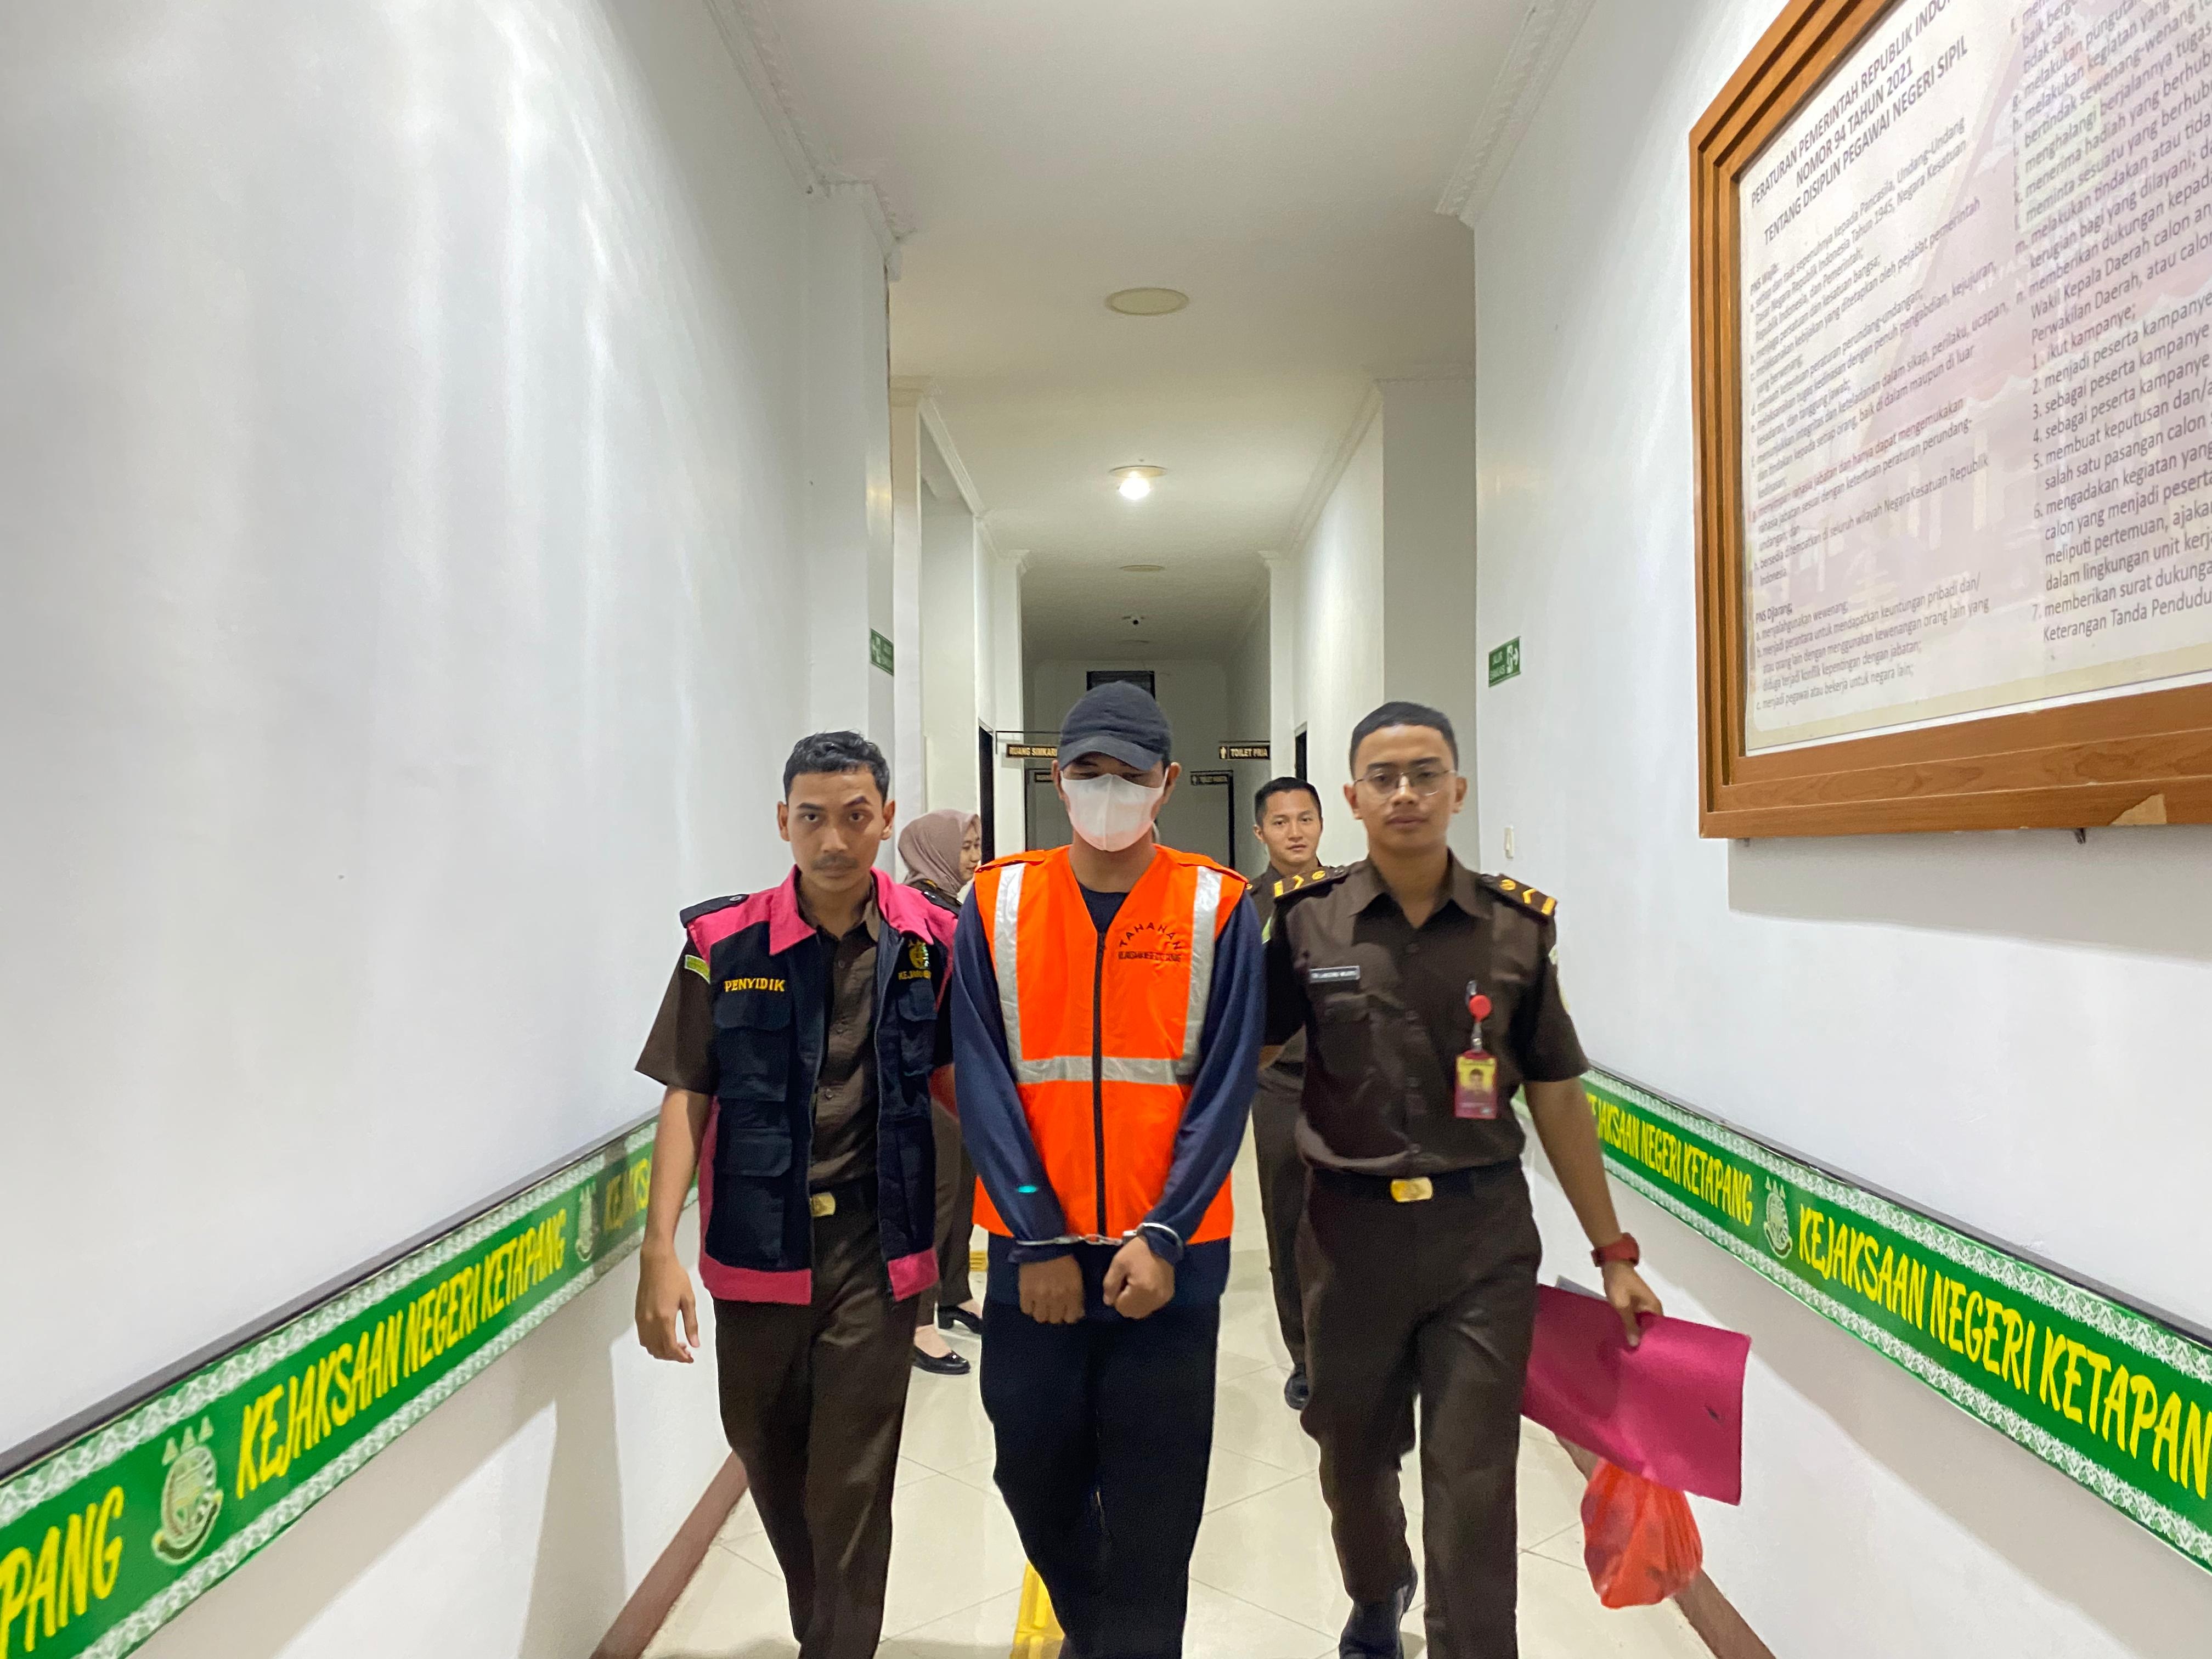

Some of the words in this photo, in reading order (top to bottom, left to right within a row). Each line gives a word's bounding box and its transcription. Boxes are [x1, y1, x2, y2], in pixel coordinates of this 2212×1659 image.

[2023, 41, 2049, 74] tidak
[2025, 41, 2082, 98] melakukan
[2086, 1, 2134, 49] punguta
[2025, 66, 2084, 120] melakukan
[2087, 22, 2136, 71] kegiatan
[2140, 1, 2169, 32] yang
[2025, 97, 2076, 148] bertindak
[2080, 5, 2194, 104] sewenang-wenang
[1752, 148, 1796, 207] PERATURAN
[1799, 82, 1858, 156] PEMERINTAH
[1861, 24, 1911, 91] REPUBLIK
[1916, 0, 1949, 36] INDO
[1764, 198, 1801, 244] TENTANG
[1803, 159, 1839, 207] DISIPLIN
[1843, 110, 1889, 169] PEGAWAI
[1893, 66, 1934, 120] NEGERI
[1938, 36, 1967, 78] SIPIL
[1797, 139, 1832, 187] NOMOR
[1835, 125, 1846, 149] 94
[1848, 86, 1883, 133] TAHUN
[1887, 57, 1912, 96] 2021
[2025, 111, 2096, 172] menghalangi
[2100, 53, 2171, 116] berjalannya
[2176, 22, 2211, 57] tugas
[2026, 149, 2081, 197] menerima
[2085, 114, 2125, 154] hadiah
[2130, 91, 2159, 126] yang
[2163, 49, 2210, 97] berhub
[1897, 118, 1964, 183] Undang-Undang
[1897, 175, 1925, 205] Negara
[1927, 140, 1966, 179] Kesatuan
[2027, 180, 2074, 221] meminta
[2078, 145, 2123, 185] sesuatu
[2128, 120, 2157, 155] yang
[2162, 81, 2209, 126] berhub
[2032, 196, 2090, 243] melakukan
[2095, 157, 2147, 201] tindakan
[2152, 133, 2180, 162] atau
[2185, 112, 2210, 139] tida
[1929, 198, 1979, 248] pemerintah
[2029, 244, 2098, 293] memberikan
[2102, 203, 2163, 250] dukungan
[2030, 232, 2076, 269] kerugian
[2080, 209, 2103, 238] bagi
[2108, 191, 2136, 223] yang
[2141, 151, 2195, 198] dilayani;
[2031, 290, 2059, 319] Wakil
[2064, 268, 2101, 300] Kepala
[2106, 238, 2149, 275] Daerah
[2154, 216, 2190, 246] calon
[2032, 303, 2090, 344] Perwakilan
[2095, 273, 2142, 308] Daerah,
[2147, 253, 2175, 279] atau
[1884, 386, 1908, 406] dalam
[1910, 364, 1943, 390] maupun
[1946, 354, 1954, 370] di
[1957, 345, 1974, 363] luar
[2032, 378, 2041, 395] 2.
[2045, 354, 2089, 387] menjadi
[2094, 331, 2138, 367] peserta
[2143, 293, 2211, 336] kampanye
[2033, 403, 2041, 420] 3.
[2045, 385, 2086, 413] sebagai
[2091, 360, 2135, 396] peserta
[2140, 325, 2209, 366] kampanye
[2047, 340, 2068, 360] ikut
[2072, 304, 2135, 347] kampanye;
[2033, 428, 2041, 443] 4.
[2046, 406, 2086, 439] sebagai
[2091, 388, 2135, 422] peserta
[2140, 354, 2209, 394] kampanye
[2034, 453, 2042, 470] 5.
[2046, 429, 2100, 461] membuat
[2104, 402, 2168, 437] keputusan
[2173, 378, 2212, 409] dan/a
[1950, 454, 1988, 481] Republik
[2034, 503, 2043, 518] 6.
[2046, 478, 2118, 514] mengadakan
[2123, 456, 2176, 486] kegiatan
[2045, 466, 2073, 490] salah
[2076, 458, 2100, 477] satu
[2104, 432, 2163, 470] pasangan
[2167, 415, 2205, 440] calon
[2045, 521, 2073, 540] calon
[2078, 509, 2104, 533] yang
[2108, 486, 2158, 517] menjadi
[2046, 537, 2090, 565] meliputi
[2095, 518, 2168, 554] pertemuan,
[2173, 501, 2211, 528] ajaka
[1928, 582, 1957, 606] pribadi
[1960, 572, 1980, 592] dan/
[2045, 588, 2115, 616] memberikan
[2120, 575, 2151, 597] surat
[2155, 561, 2212, 587] dukunga
[2046, 571, 2079, 590] dalam
[2083, 551, 2148, 580] lingkungan
[2153, 538, 2179, 560] unit
[1924, 611, 1948, 627] orang
[1950, 605, 1965, 619] lain
[1968, 598, 1989, 616] yang
[2044, 617, 2106, 640] Keterangan
[2111, 603, 2147, 625] Tanda
[2152, 588, 2211, 616] Pendudu
[1230, 748, 1252, 757] TOILET
[1119, 922, 1181, 950] TAHANAN
[724, 978, 785, 992] PENYIDIK
[1641, 1121, 1681, 1184] NEGERI
[1683, 1143, 1753, 1227] KETAPANG
[236, 1310, 403, 1500] KEJAKSAAN
[403, 1263, 481, 1378] NEGERI
[481, 1208, 567, 1323] KETAPANG
[1799, 1205, 1926, 1328] KEJAKSAAN
[1929, 1271, 2036, 1395] NEGERI
[2039, 1327, 2212, 1499] KETAPAN
[0, 1486, 125, 1659] PANG
